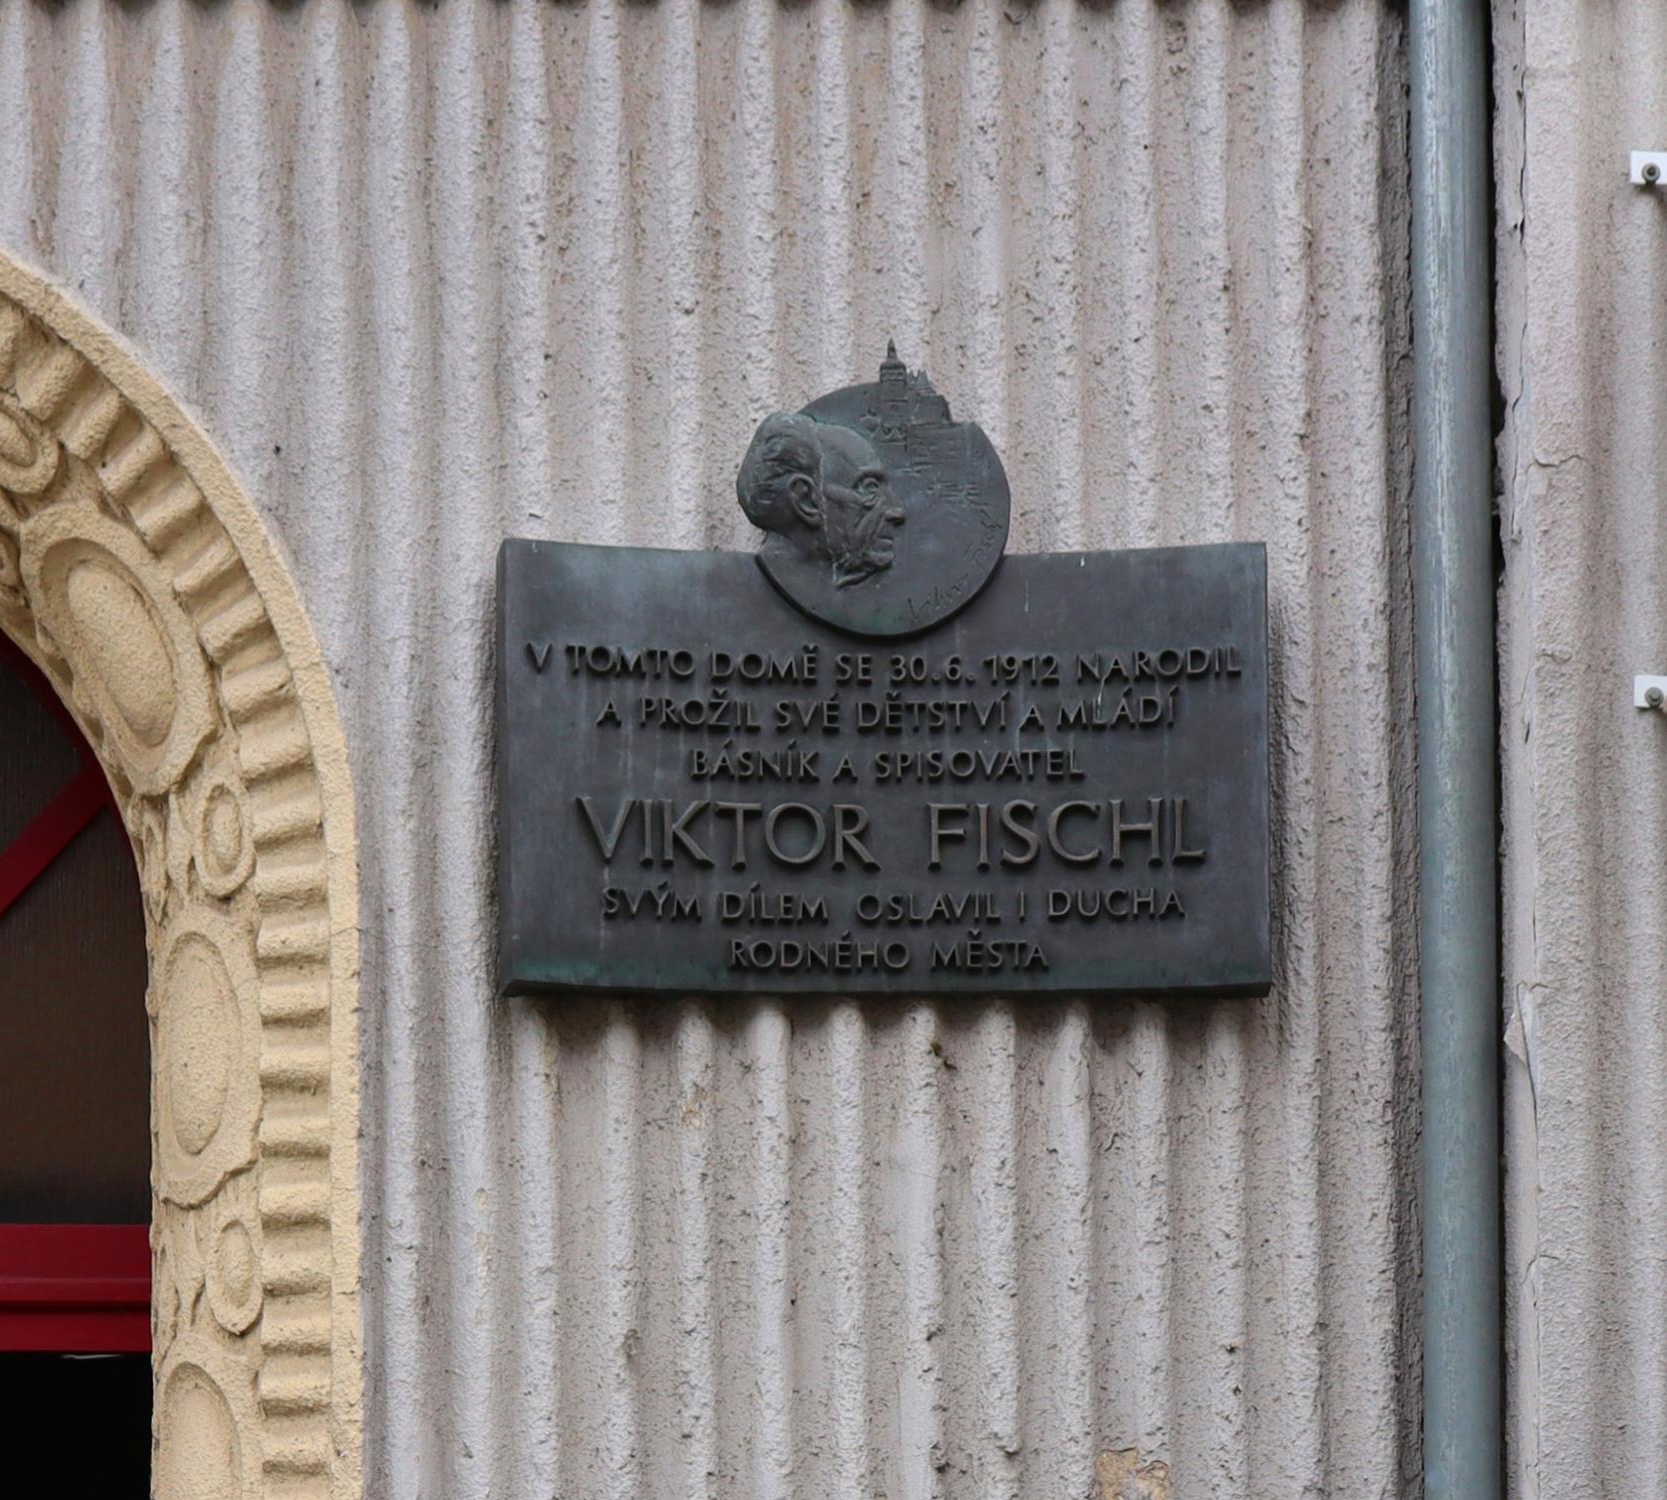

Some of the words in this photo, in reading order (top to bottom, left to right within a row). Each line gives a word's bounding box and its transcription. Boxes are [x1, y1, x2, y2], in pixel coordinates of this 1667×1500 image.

[527, 643, 553, 673] V
[566, 645, 696, 679] TOMTO
[710, 643, 820, 685] DOMĚ
[835, 653, 874, 685] SE
[983, 654, 1061, 685] 1912
[1076, 646, 1242, 684] NARODIL
[595, 701, 623, 728] A
[639, 687, 762, 732] PROŽIL
[775, 693, 841, 733] SVÉ
[857, 691, 1011, 733] DĚTSTVÍ
[1018, 703, 1046, 732] A
[1056, 686, 1180, 731] MLÁDÍ
[689, 739, 821, 784] BÁSNÍK
[832, 753, 859, 783] A
[874, 749, 1086, 784] SPISOVATEL
[576, 796, 882, 871] VIKTOR
[927, 797, 1206, 872] FISCHL
[602, 881, 703, 923] SVÝM
[720, 881, 829, 925] DÍLEM
[856, 893, 1002, 924] OSLAVIL
[1017, 892, 1027, 921] I
[1047, 888, 1186, 922] DUCHA
[729, 931, 911, 971] RODNÉHO
[931, 929, 1050, 971] MĚSTA
